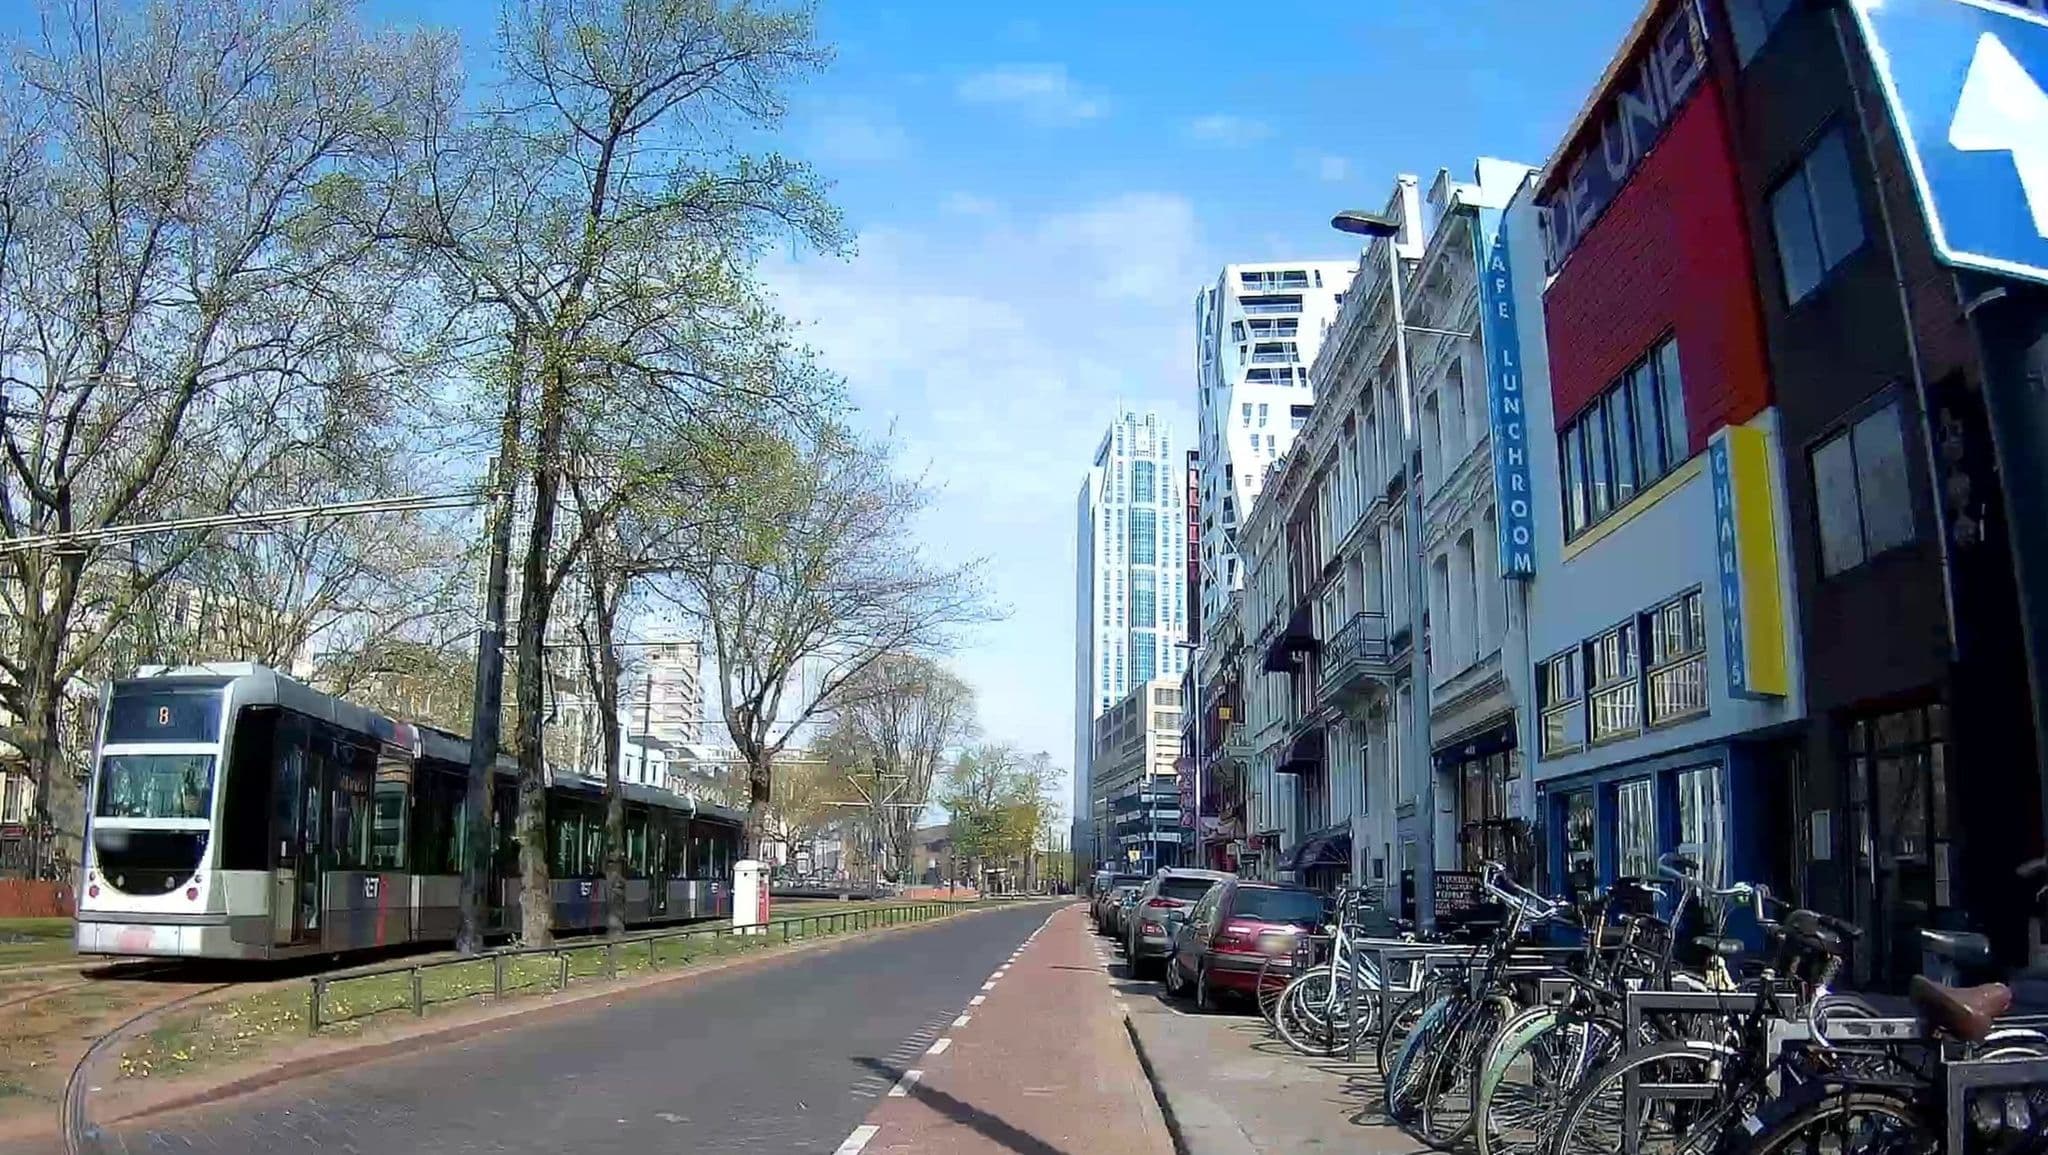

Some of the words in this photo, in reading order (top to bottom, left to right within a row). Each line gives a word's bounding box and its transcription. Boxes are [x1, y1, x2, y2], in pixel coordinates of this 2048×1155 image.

[1550, 148, 1597, 266] DE
[1601, 6, 1705, 181] UNIE
[1503, 349, 1533, 573] LUNCHROOM
[159, 705, 169, 725] 8
